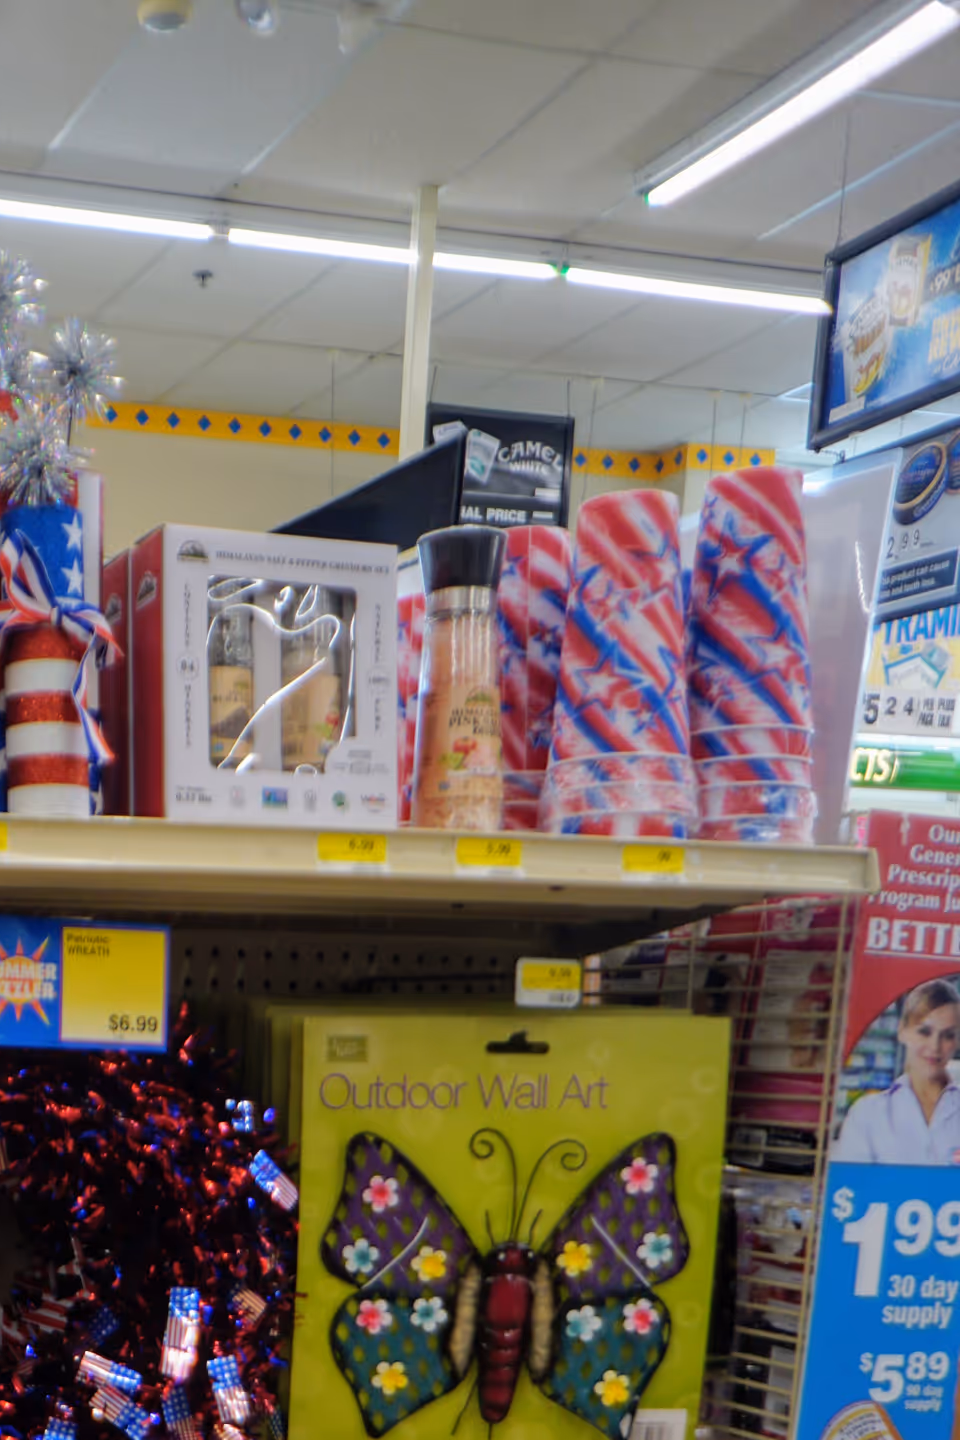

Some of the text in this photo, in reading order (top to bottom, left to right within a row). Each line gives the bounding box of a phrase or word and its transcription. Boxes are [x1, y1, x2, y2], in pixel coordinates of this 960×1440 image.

[497, 440, 563, 471] CAMEL
[486, 507, 528, 522] PRICE
[66, 933, 109, 944] Patriotic
[68, 946, 110, 957] WREATH
[108, 1013, 158, 1033] $6.99
[319, 1072, 610, 1111] Outdoor Wall Art
[887, 1275, 958, 1304] 30 day
[882, 1302, 953, 1329] supply
[922, 1384, 944, 1398] day
[904, 1399, 942, 1412] supply
